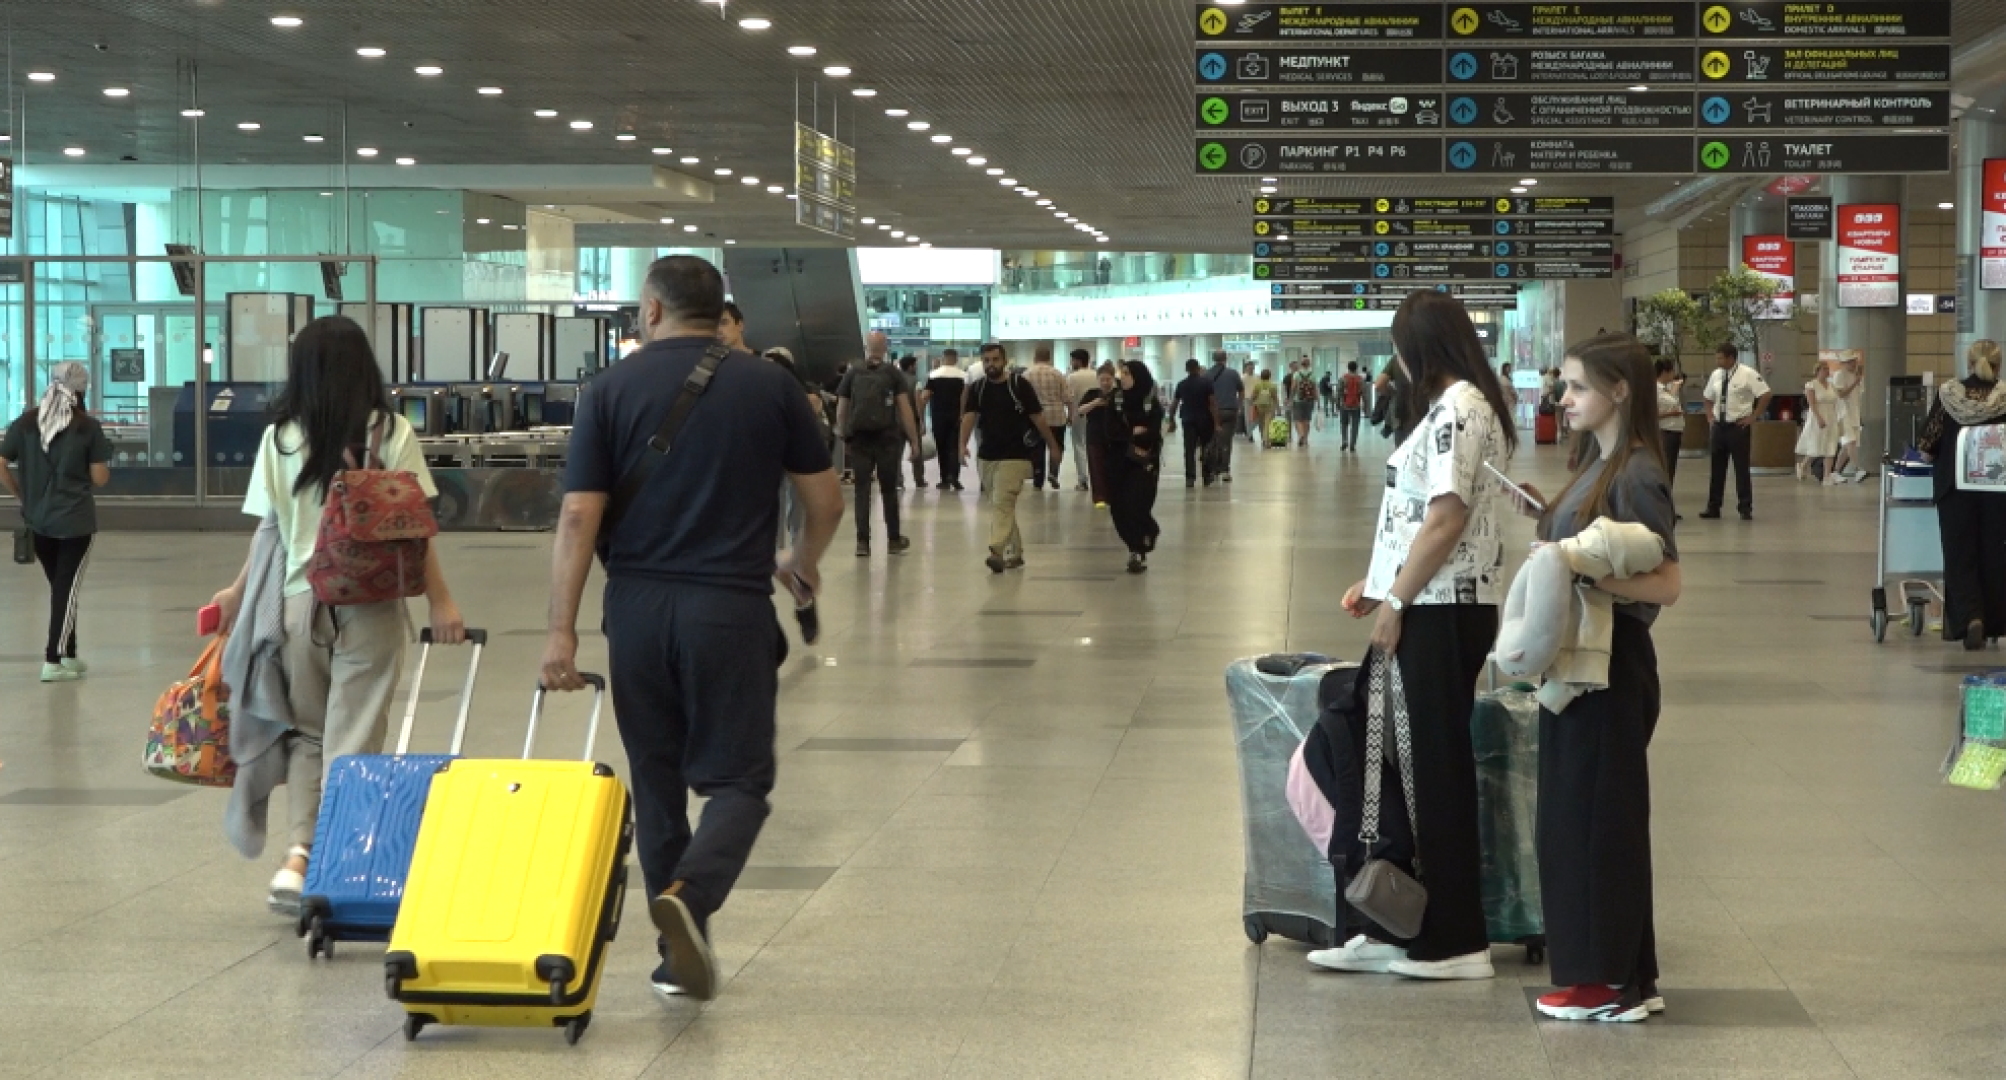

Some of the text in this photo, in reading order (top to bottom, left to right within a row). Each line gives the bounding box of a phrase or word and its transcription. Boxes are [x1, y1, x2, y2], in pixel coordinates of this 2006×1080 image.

[1532, 6, 1568, 15] ПРИЛЕТ
[1784, 5, 1820, 13] ПРИЛЕТ
[1532, 16, 1673, 25] МЕЖДУНАРОДНЫЕ АВИАЛИНИИ
[1784, 14, 1902, 23] ВНУТРЕННИЕ АВИАЛИНИИ
[1784, 26, 1825, 34] DOMESTIC
[1531, 51, 1605, 59] РОЗЫСК БАГАЖА
[1784, 50, 1802, 59] ЗАЛ
[1279, 56, 1350, 69] МЕДПУНКТ
[1531, 61, 1673, 70] МЕЖДУНАРОДНЫЕ АВИАЛИНИИ
[1793, 60, 1848, 70] ДЕЛЕГАЦИЙ
[1279, 73, 1314, 81] MEDICAL
[1316, 73, 1353, 81] SERVICES
[1531, 96, 1627, 105] ОБСЛУЖИВАНИЕ ЛИЦ
[1784, 97, 1931, 109] ВЕТЕРИНАРНЫЙ КОНТРОЛЬ
[1281, 100, 1339, 113] ВЫХОД 3
[1350, 100, 1405, 111] Яндекс Go
[1539, 105, 1611, 114] ОГРАНИЧЕННОЙ
[1613, 106, 1692, 115] ПОДВИЖНОСТЬЮ
[1244, 106, 1264, 115] EXIT
[1784, 116, 1834, 124] VETERINARY
[1836, 116, 1874, 124] CONTROL
[1531, 141, 1574, 149] КОМНАТА
[1784, 144, 1833, 155] ТУАЛЕТ
[1280, 146, 1338, 158] ПАРКИНГ
[1531, 151, 1567, 159] МАТЕРИ
[1784, 160, 1811, 168] TOILET
